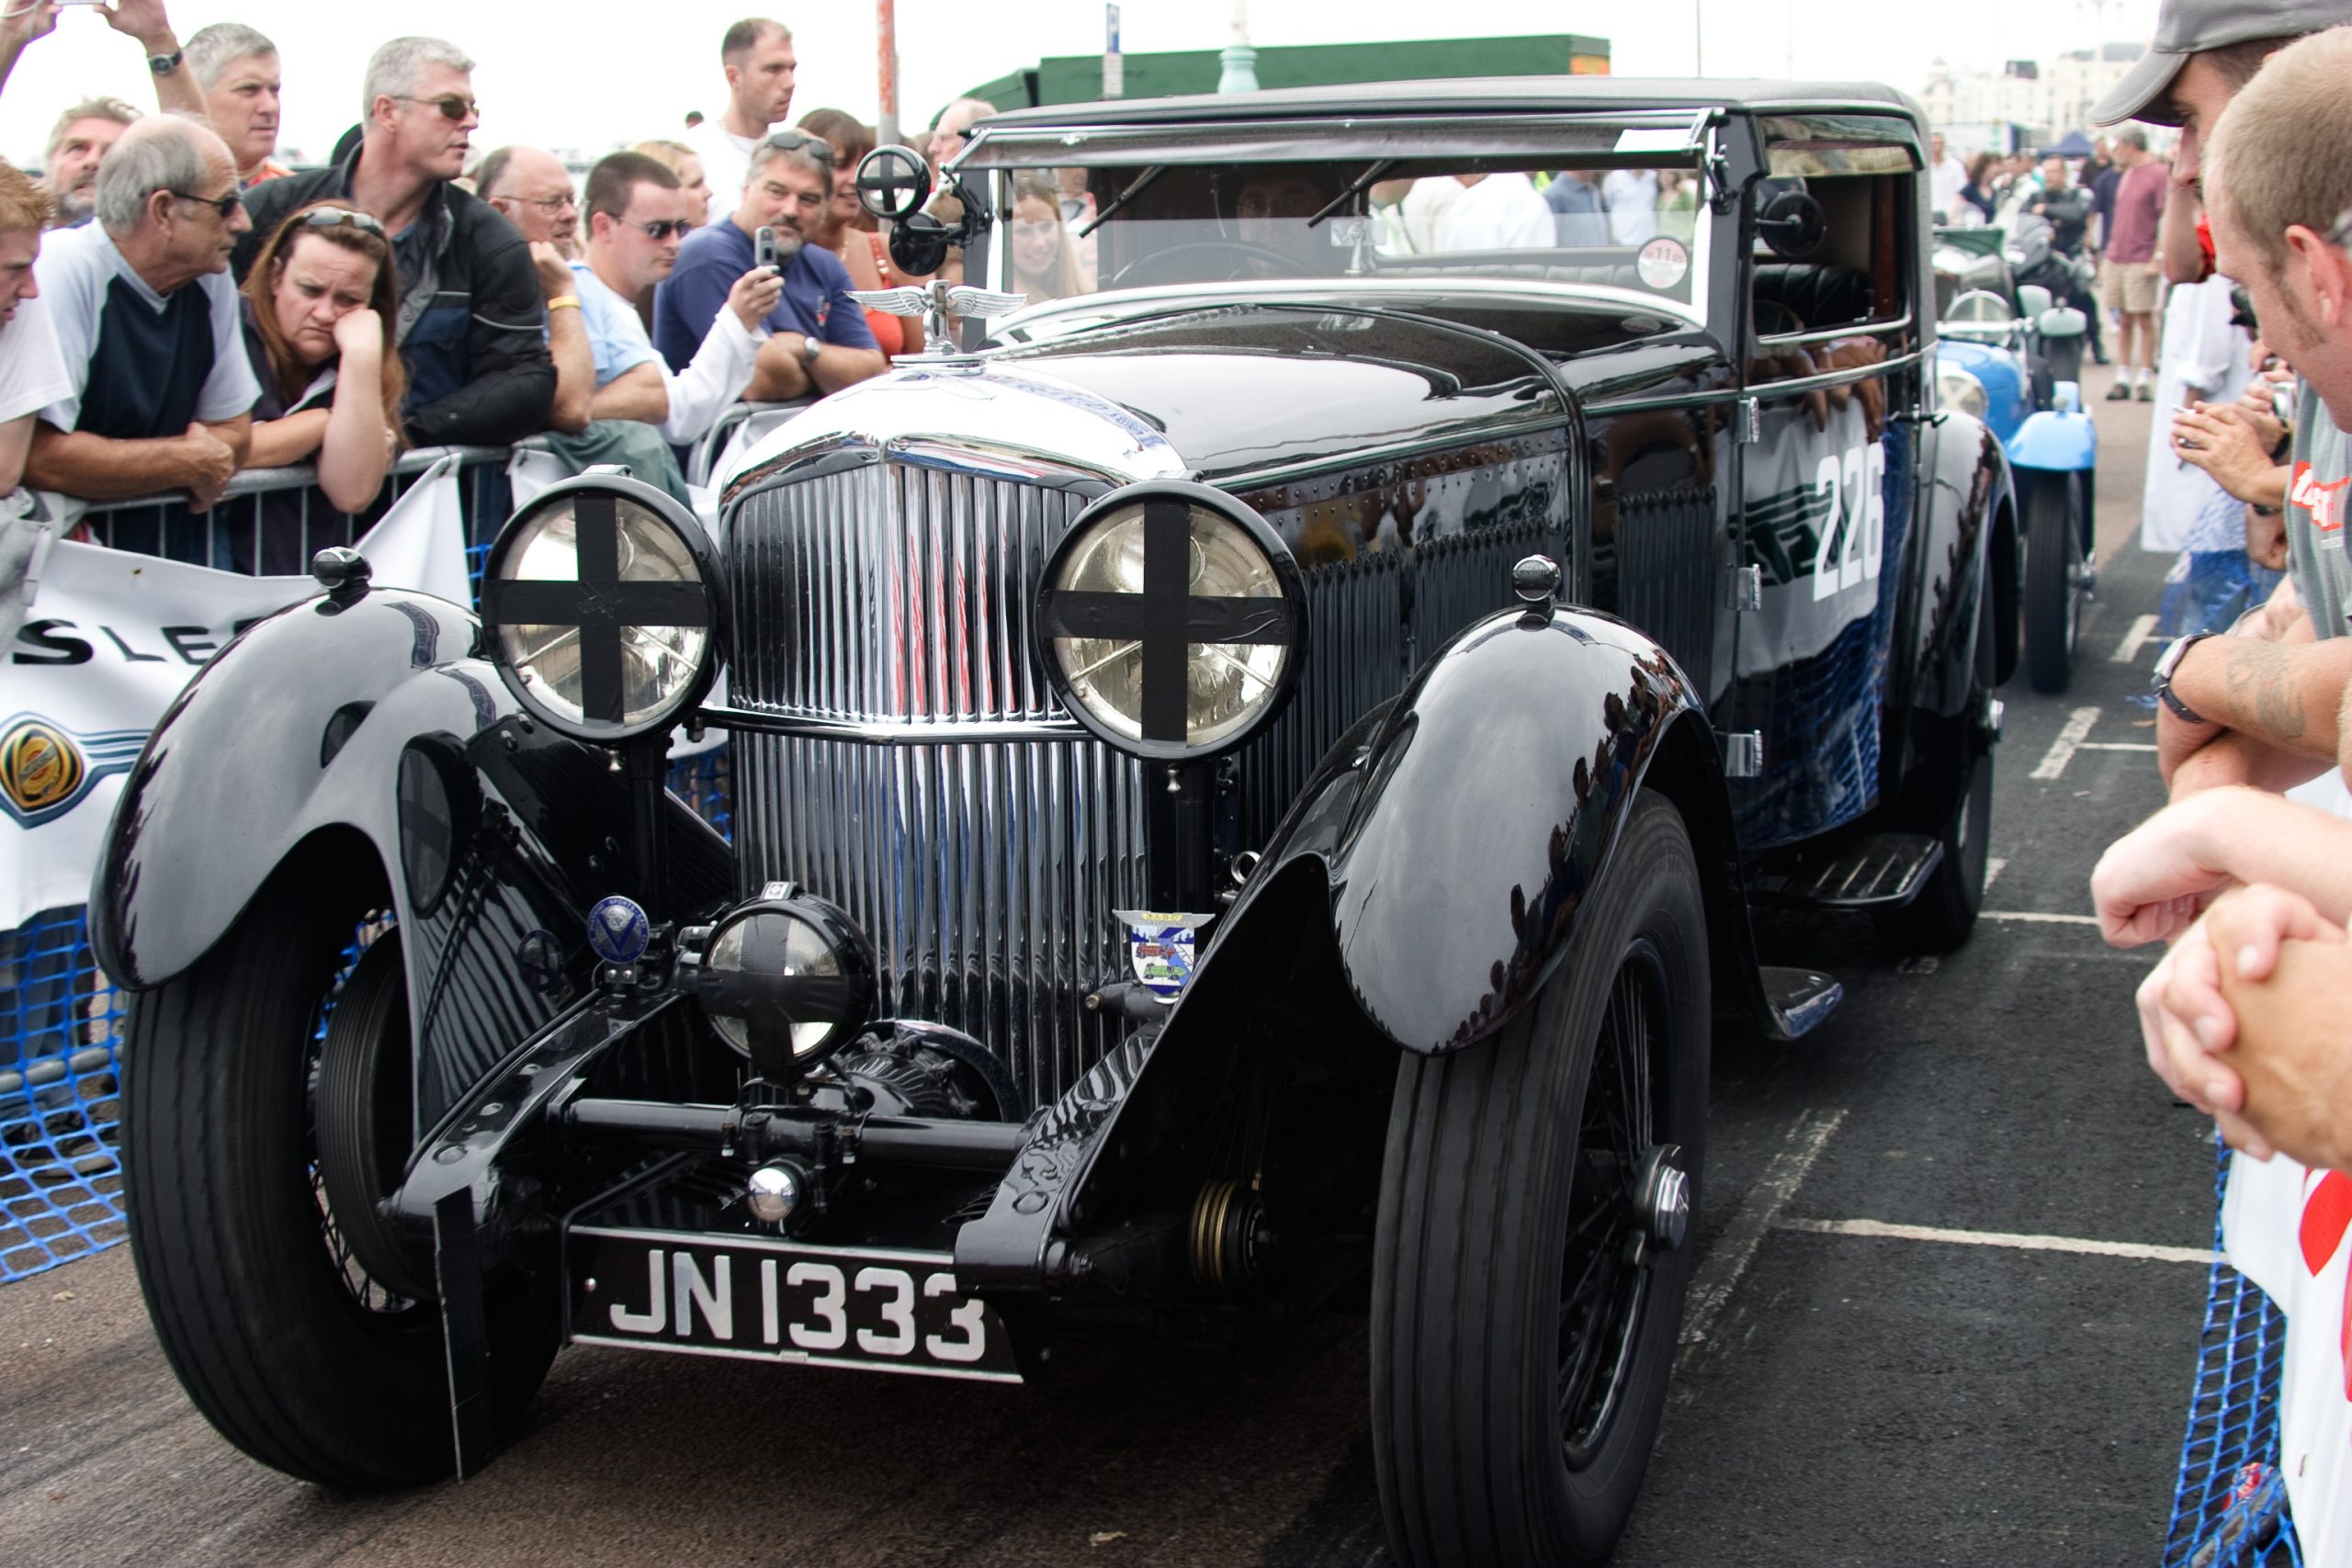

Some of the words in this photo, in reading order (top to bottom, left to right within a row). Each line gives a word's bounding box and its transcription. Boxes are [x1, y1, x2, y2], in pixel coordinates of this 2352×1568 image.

[1814, 442, 1885, 602] 226
[609, 1249, 733, 1340] JN
[761, 1259, 986, 1362] 1333
